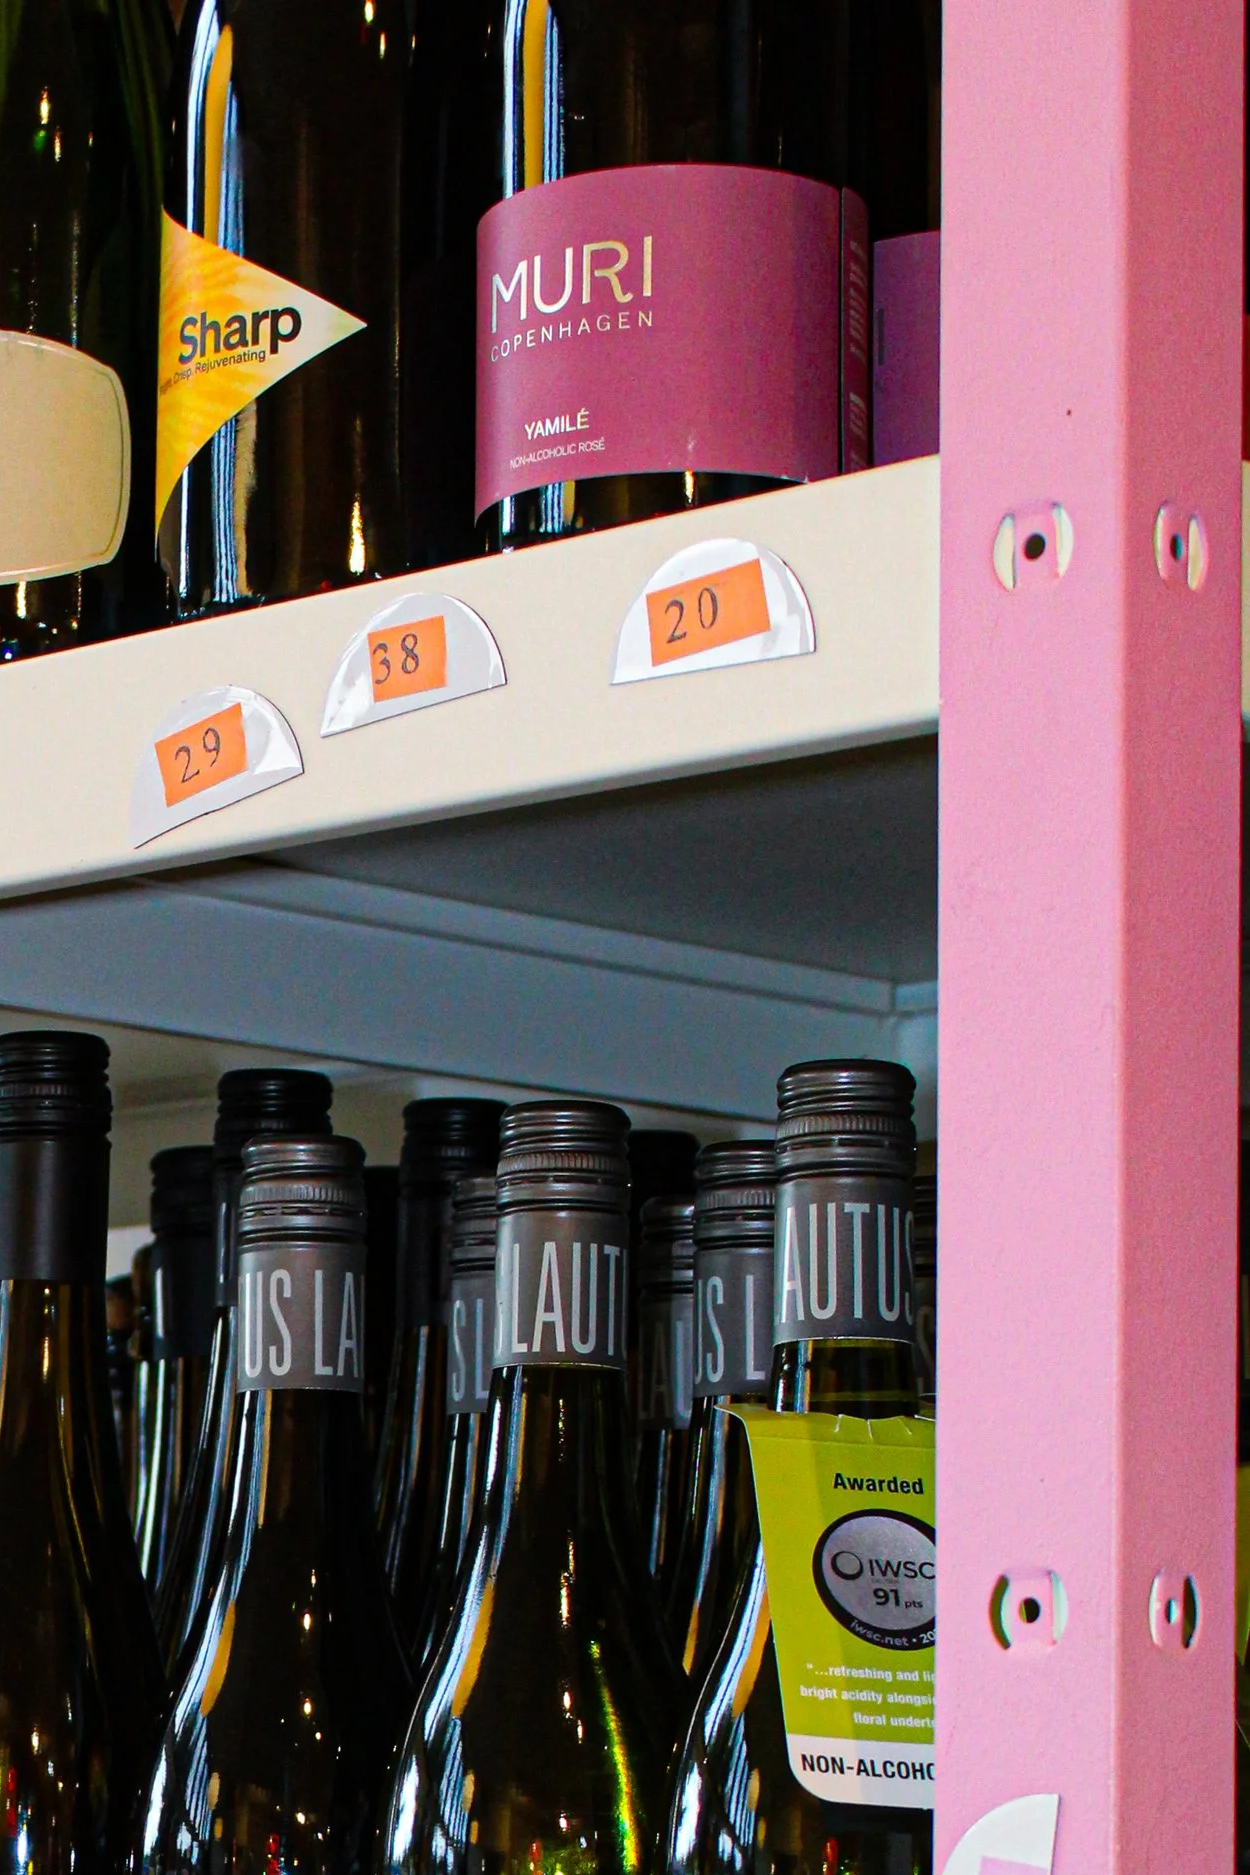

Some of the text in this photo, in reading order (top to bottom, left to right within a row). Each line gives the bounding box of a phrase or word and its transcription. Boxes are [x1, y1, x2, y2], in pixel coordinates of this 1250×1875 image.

[492, 235, 653, 334] MURI
[179, 306, 302, 365] Sharp
[490, 310, 653, 363] COPENHAGEN
[195, 350, 266, 374] Rejuvenating
[524, 407, 590, 441] YAMILÉ
[509, 436, 605, 470] NON-ALCOHOLIC ROSÉ
[662, 585, 720, 646] 20
[372, 632, 420, 687] 38
[174, 726, 222, 784] 29
[511, 1241, 628, 1360] LAUT
[238, 1269, 292, 1379] US
[314, 1269, 364, 1379] LA
[833, 1472, 924, 1496] Awarded
[868, 1558, 935, 1580] IWSC
[873, 1588, 923, 1609] 91 pts
[850, 1620, 909, 1646] iwsc.net
[896, 1670, 919, 1682] and
[800, 1685, 837, 1700] bright
[841, 1689, 883, 1704] acidity
[853, 1712, 886, 1726] floral
